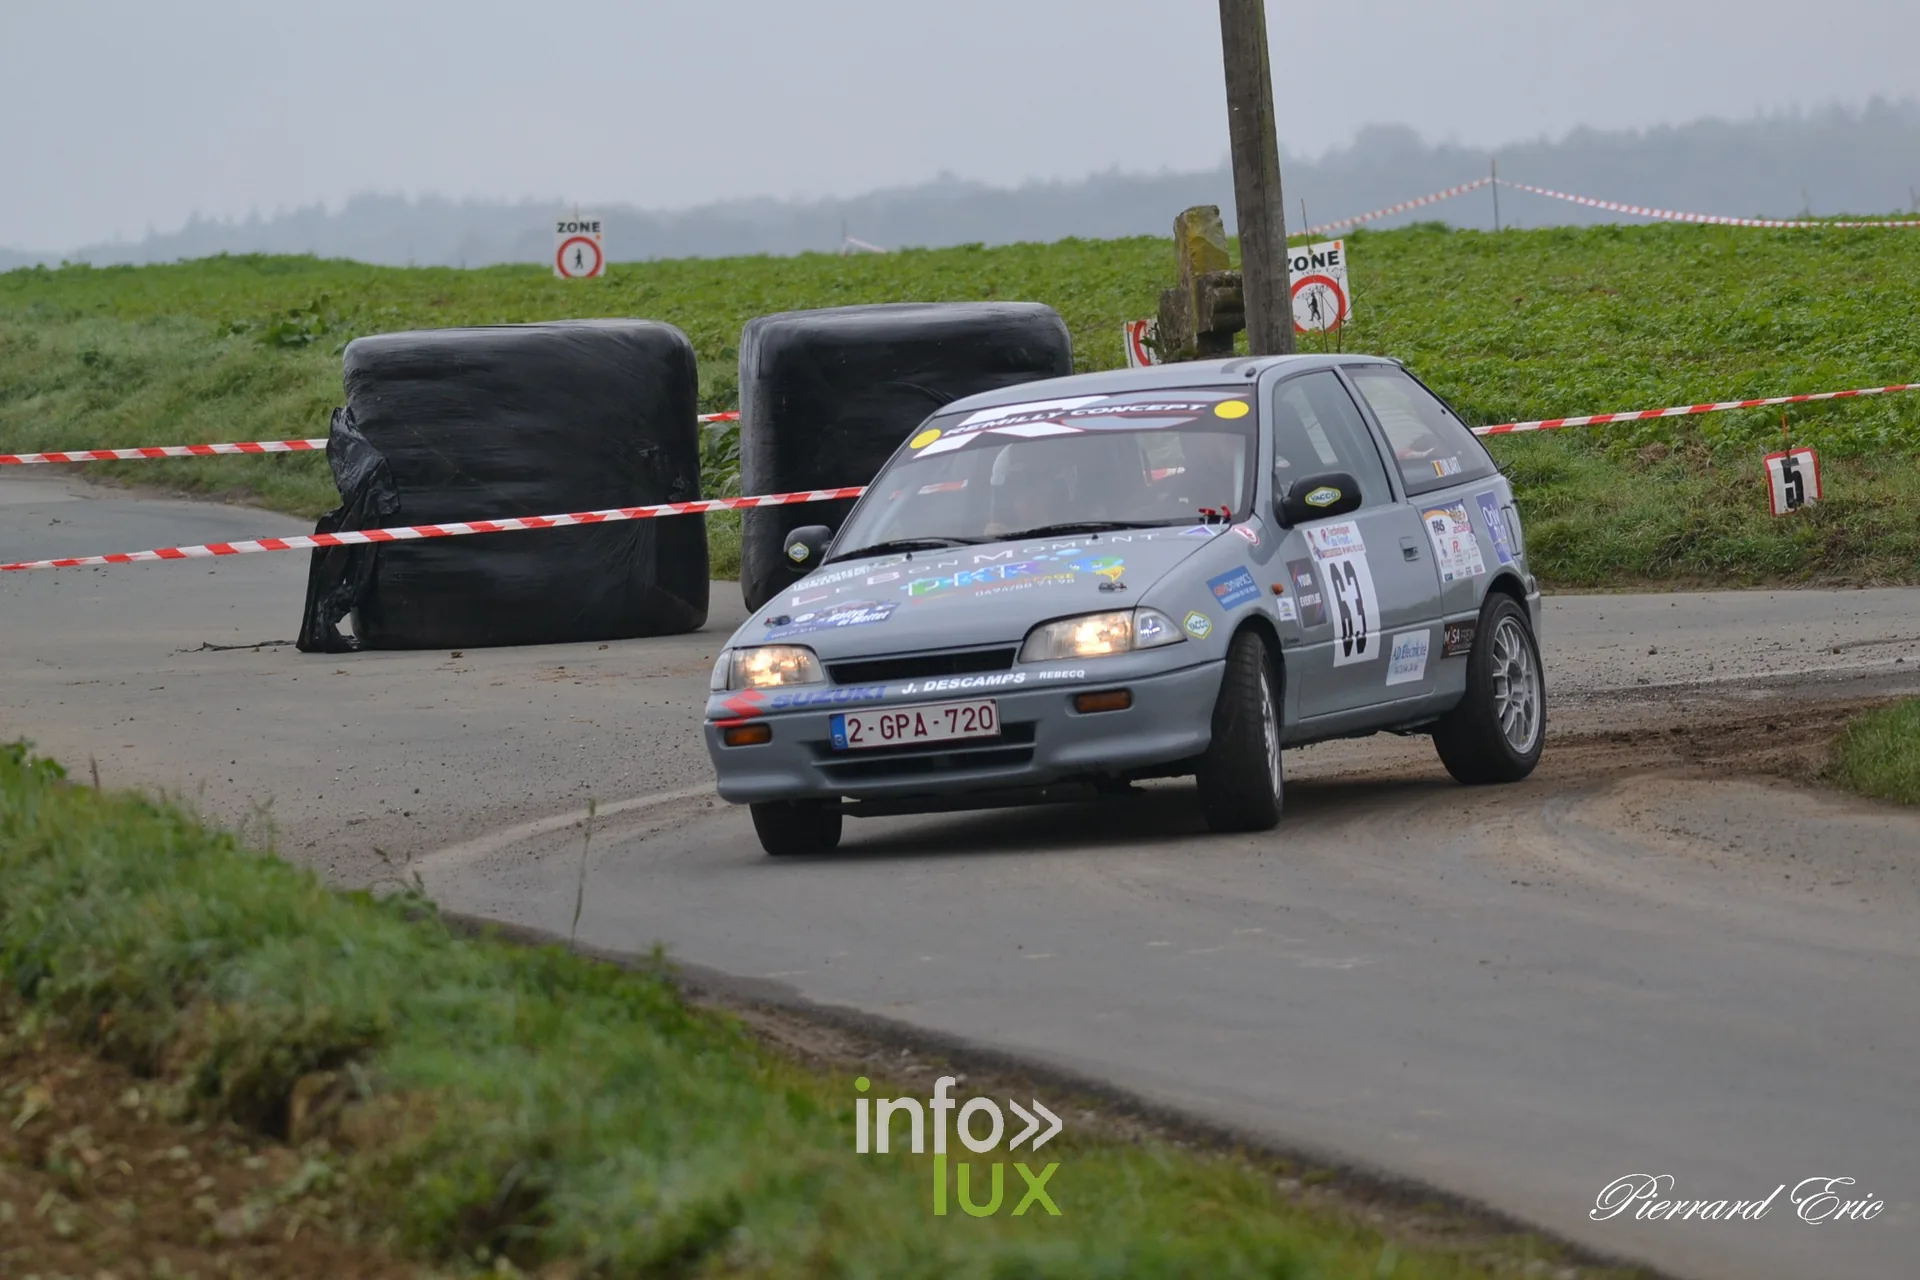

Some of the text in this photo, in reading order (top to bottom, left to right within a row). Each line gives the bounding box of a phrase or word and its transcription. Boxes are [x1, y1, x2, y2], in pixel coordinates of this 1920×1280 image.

[557, 222, 601, 233] ZONE
[1070, 403, 1207, 417] CONCEPT
[1780, 457, 1804, 508] 5
[974, 534, 1160, 563] MOMENT
[1329, 560, 1367, 657] 63
[770, 669, 1085, 709] SUZUKI J. DESCAMPS REBECQ
